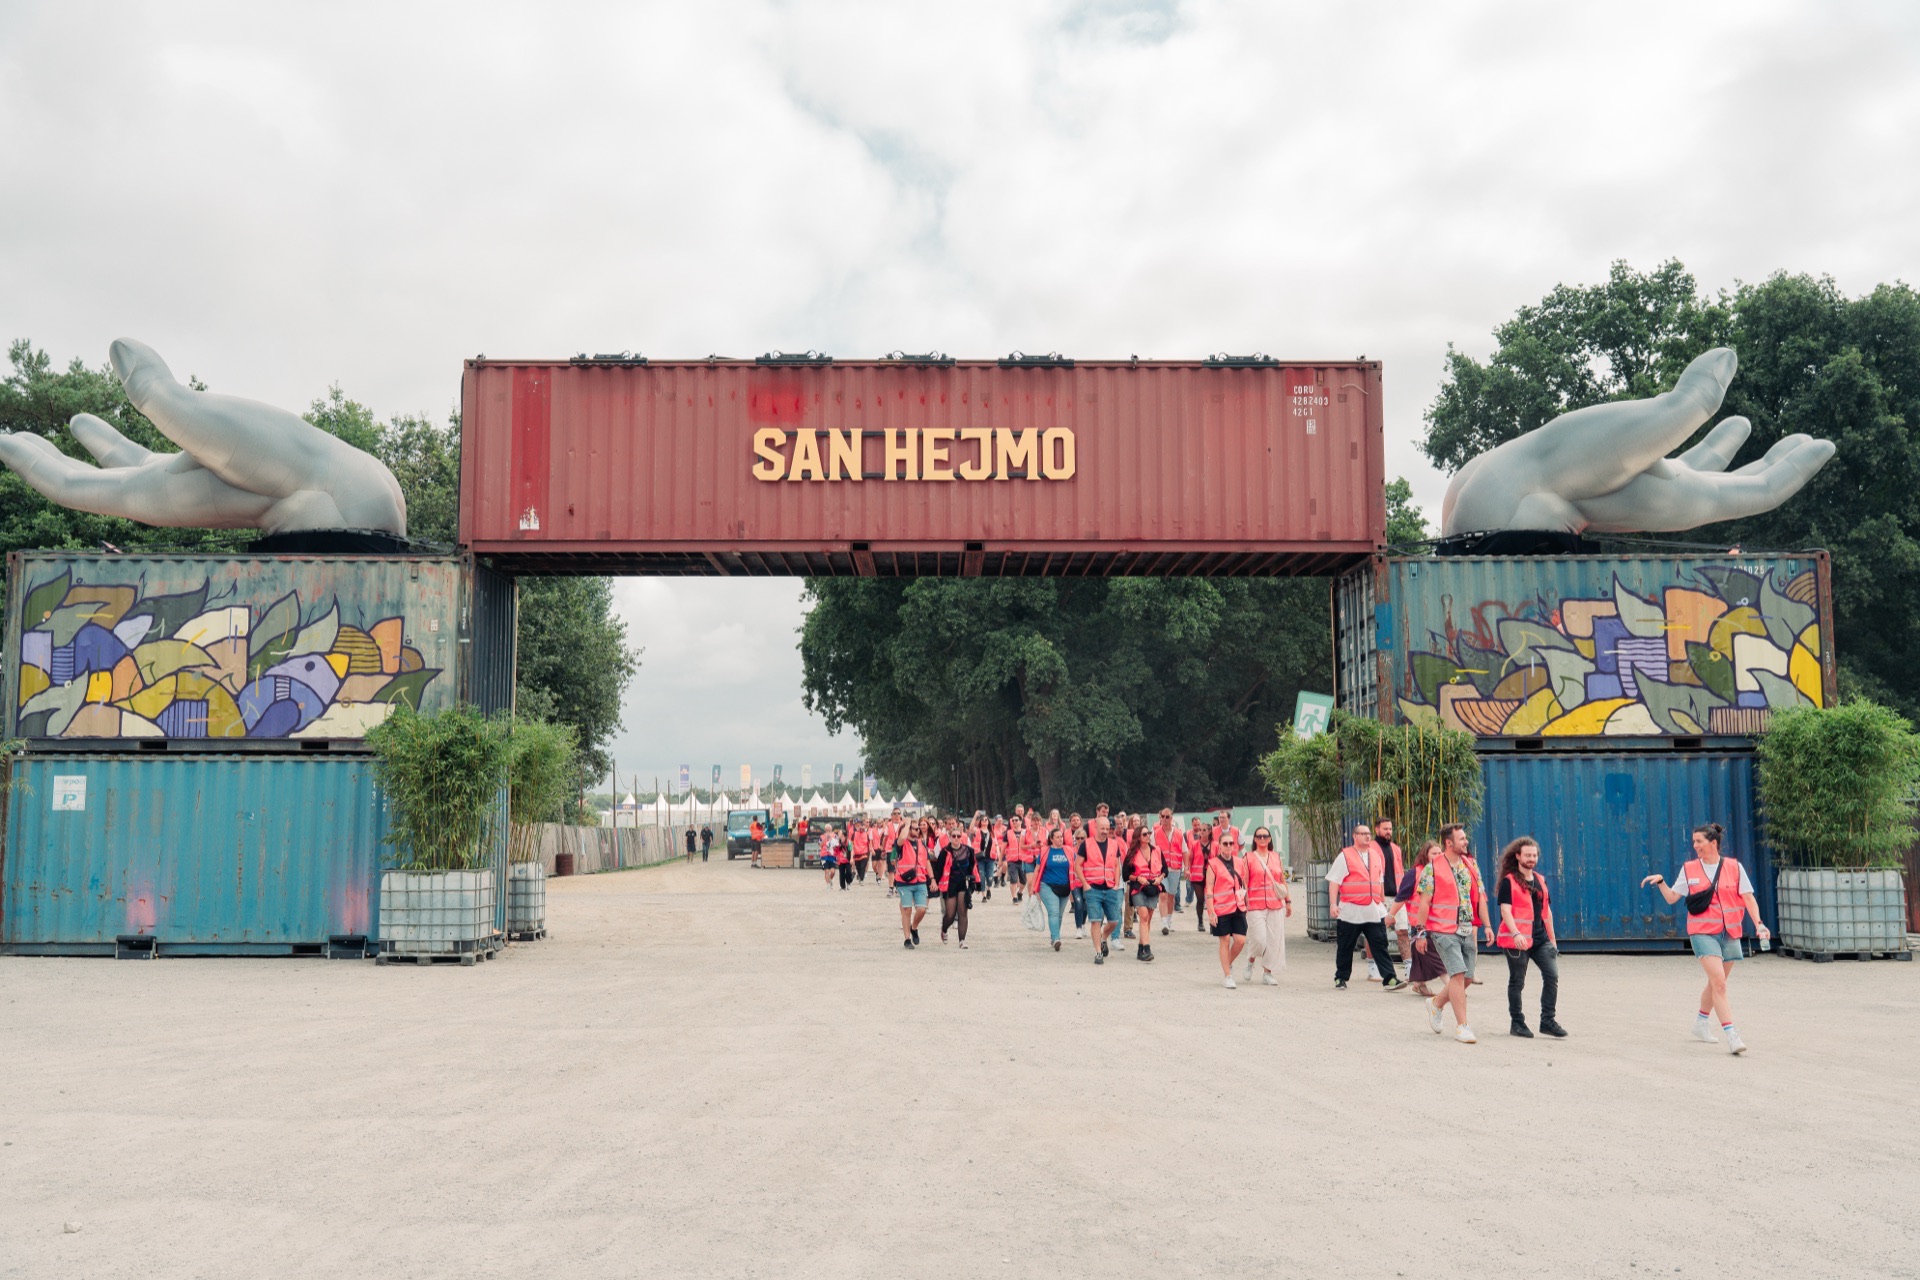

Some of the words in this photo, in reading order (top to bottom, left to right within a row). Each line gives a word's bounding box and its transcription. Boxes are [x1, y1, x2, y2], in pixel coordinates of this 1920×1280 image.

[1293, 385, 1314, 394] CORU
[1292, 396, 1329, 406] 4282403
[1292, 407, 1313, 417] 42G1
[752, 427, 863, 481] SAN
[884, 427, 1075, 481] HEJMO
